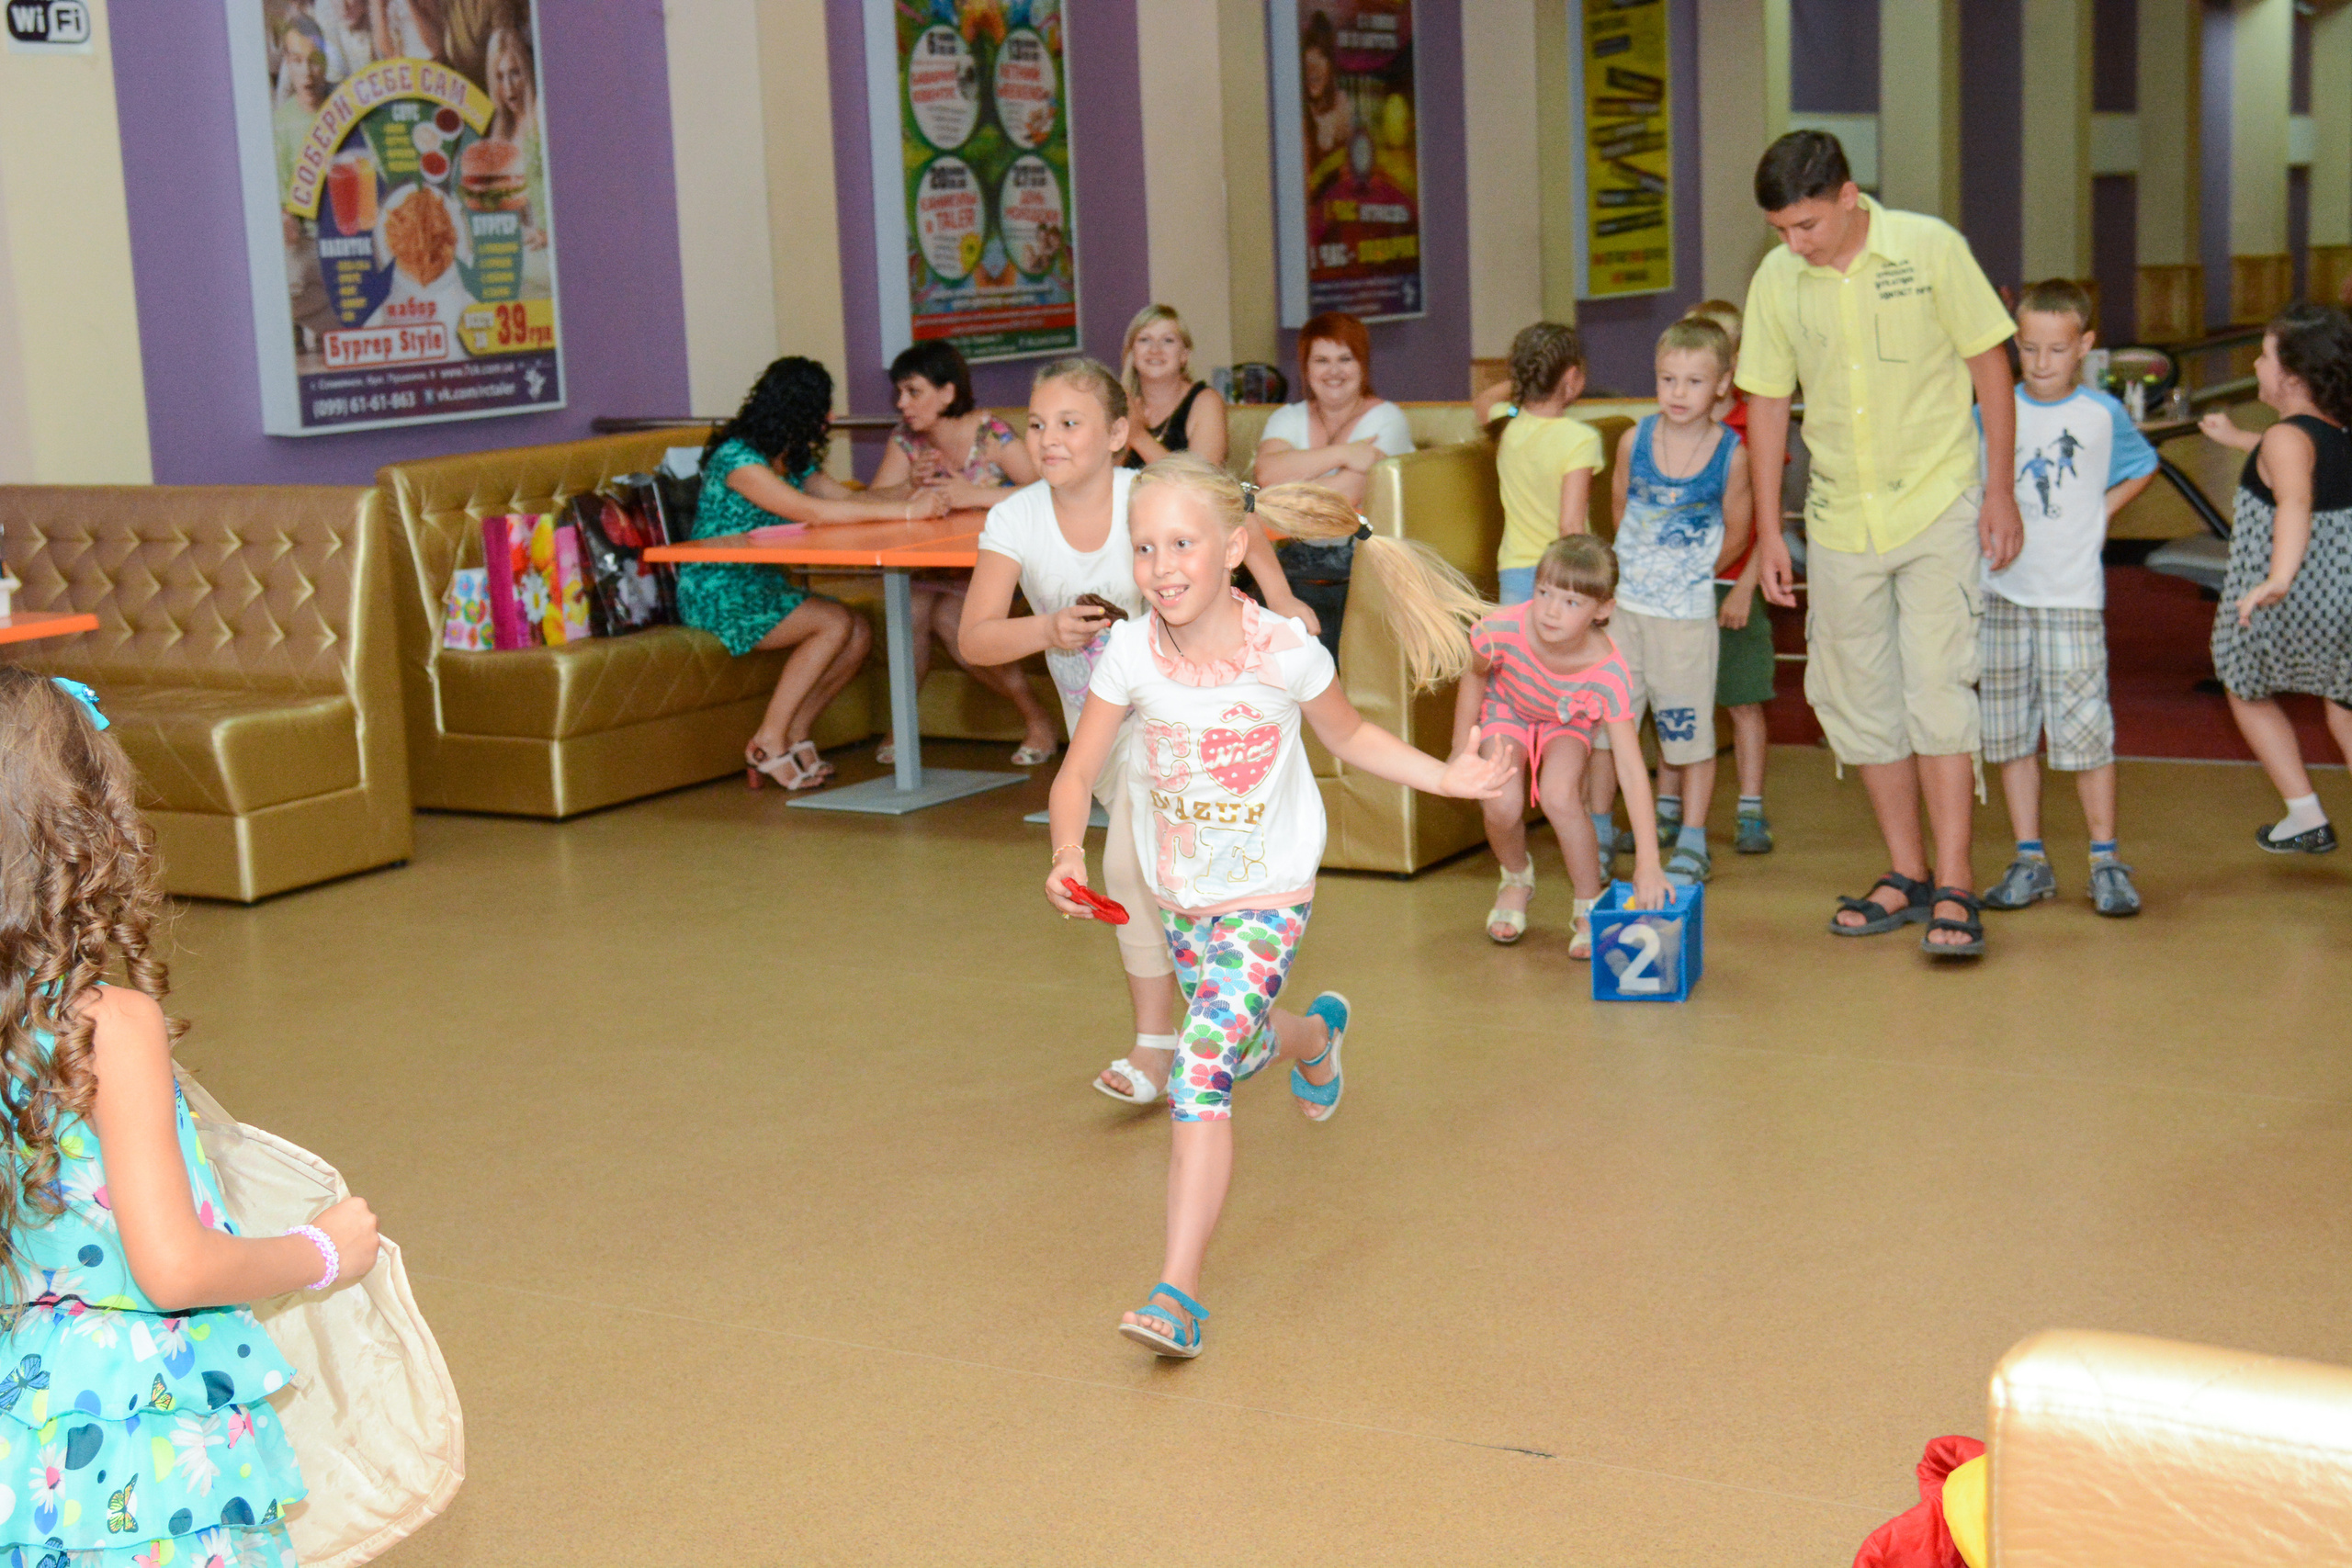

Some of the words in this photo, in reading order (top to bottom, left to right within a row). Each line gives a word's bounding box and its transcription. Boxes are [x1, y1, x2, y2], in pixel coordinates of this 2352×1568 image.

[11, 5, 46, 33] Wi
[56, 8, 81, 31] Fi
[292, 94, 355, 209] СОБЕРИ
[353, 62, 413, 107] СЕБЕ
[387, 296, 437, 320] набор
[495, 302, 527, 346] 39
[329, 334, 393, 363] Бургер
[400, 329, 443, 356] Style
[1618, 923, 1661, 991] 2
